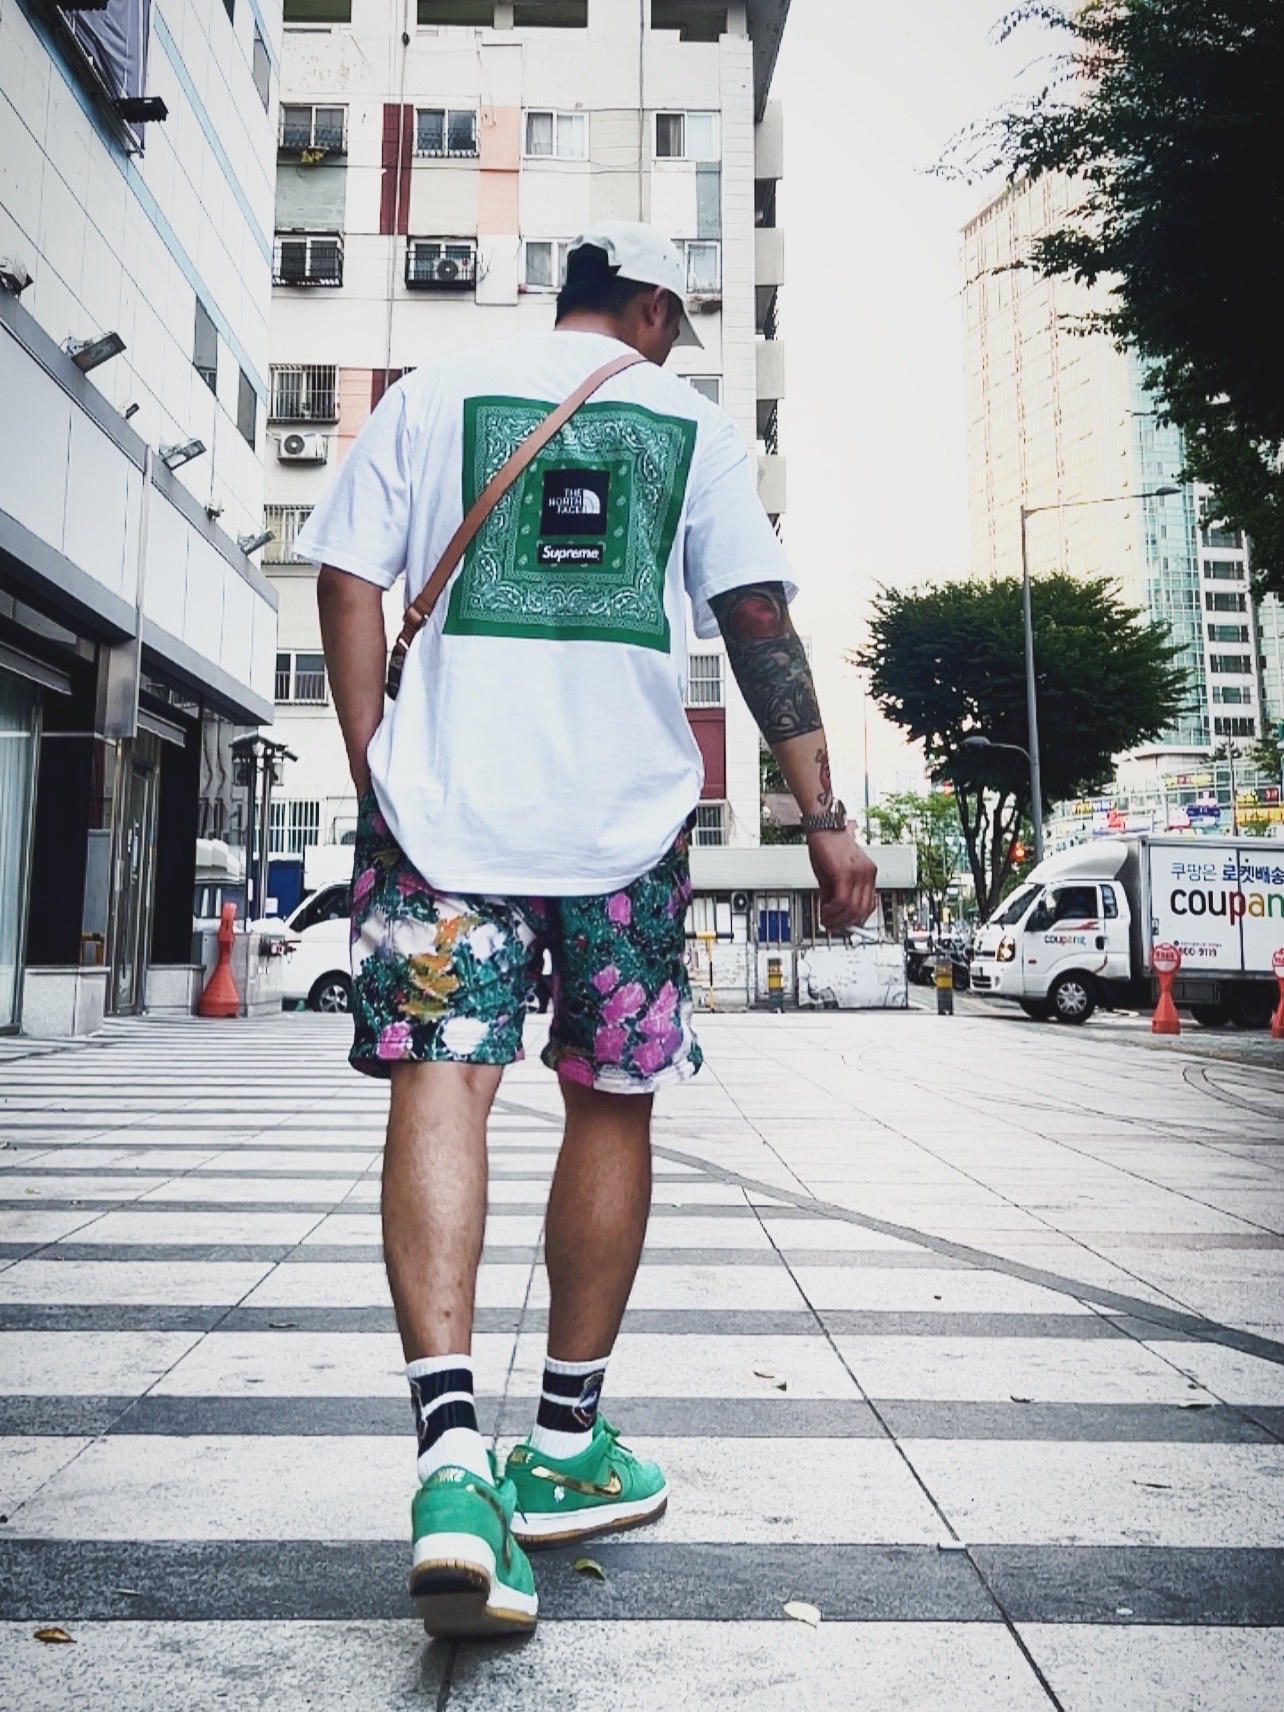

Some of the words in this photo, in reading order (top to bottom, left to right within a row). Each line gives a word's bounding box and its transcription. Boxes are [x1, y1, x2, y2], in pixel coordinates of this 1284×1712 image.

[565, 488, 582, 497] THE
[549, 496, 582, 507] NORTH
[557, 506, 582, 514] FACE
[542, 545, 599, 562] Supreme
[1171, 862, 1217, 881] 쿠팡은
[1222, 864, 1284, 885] 로켓배송
